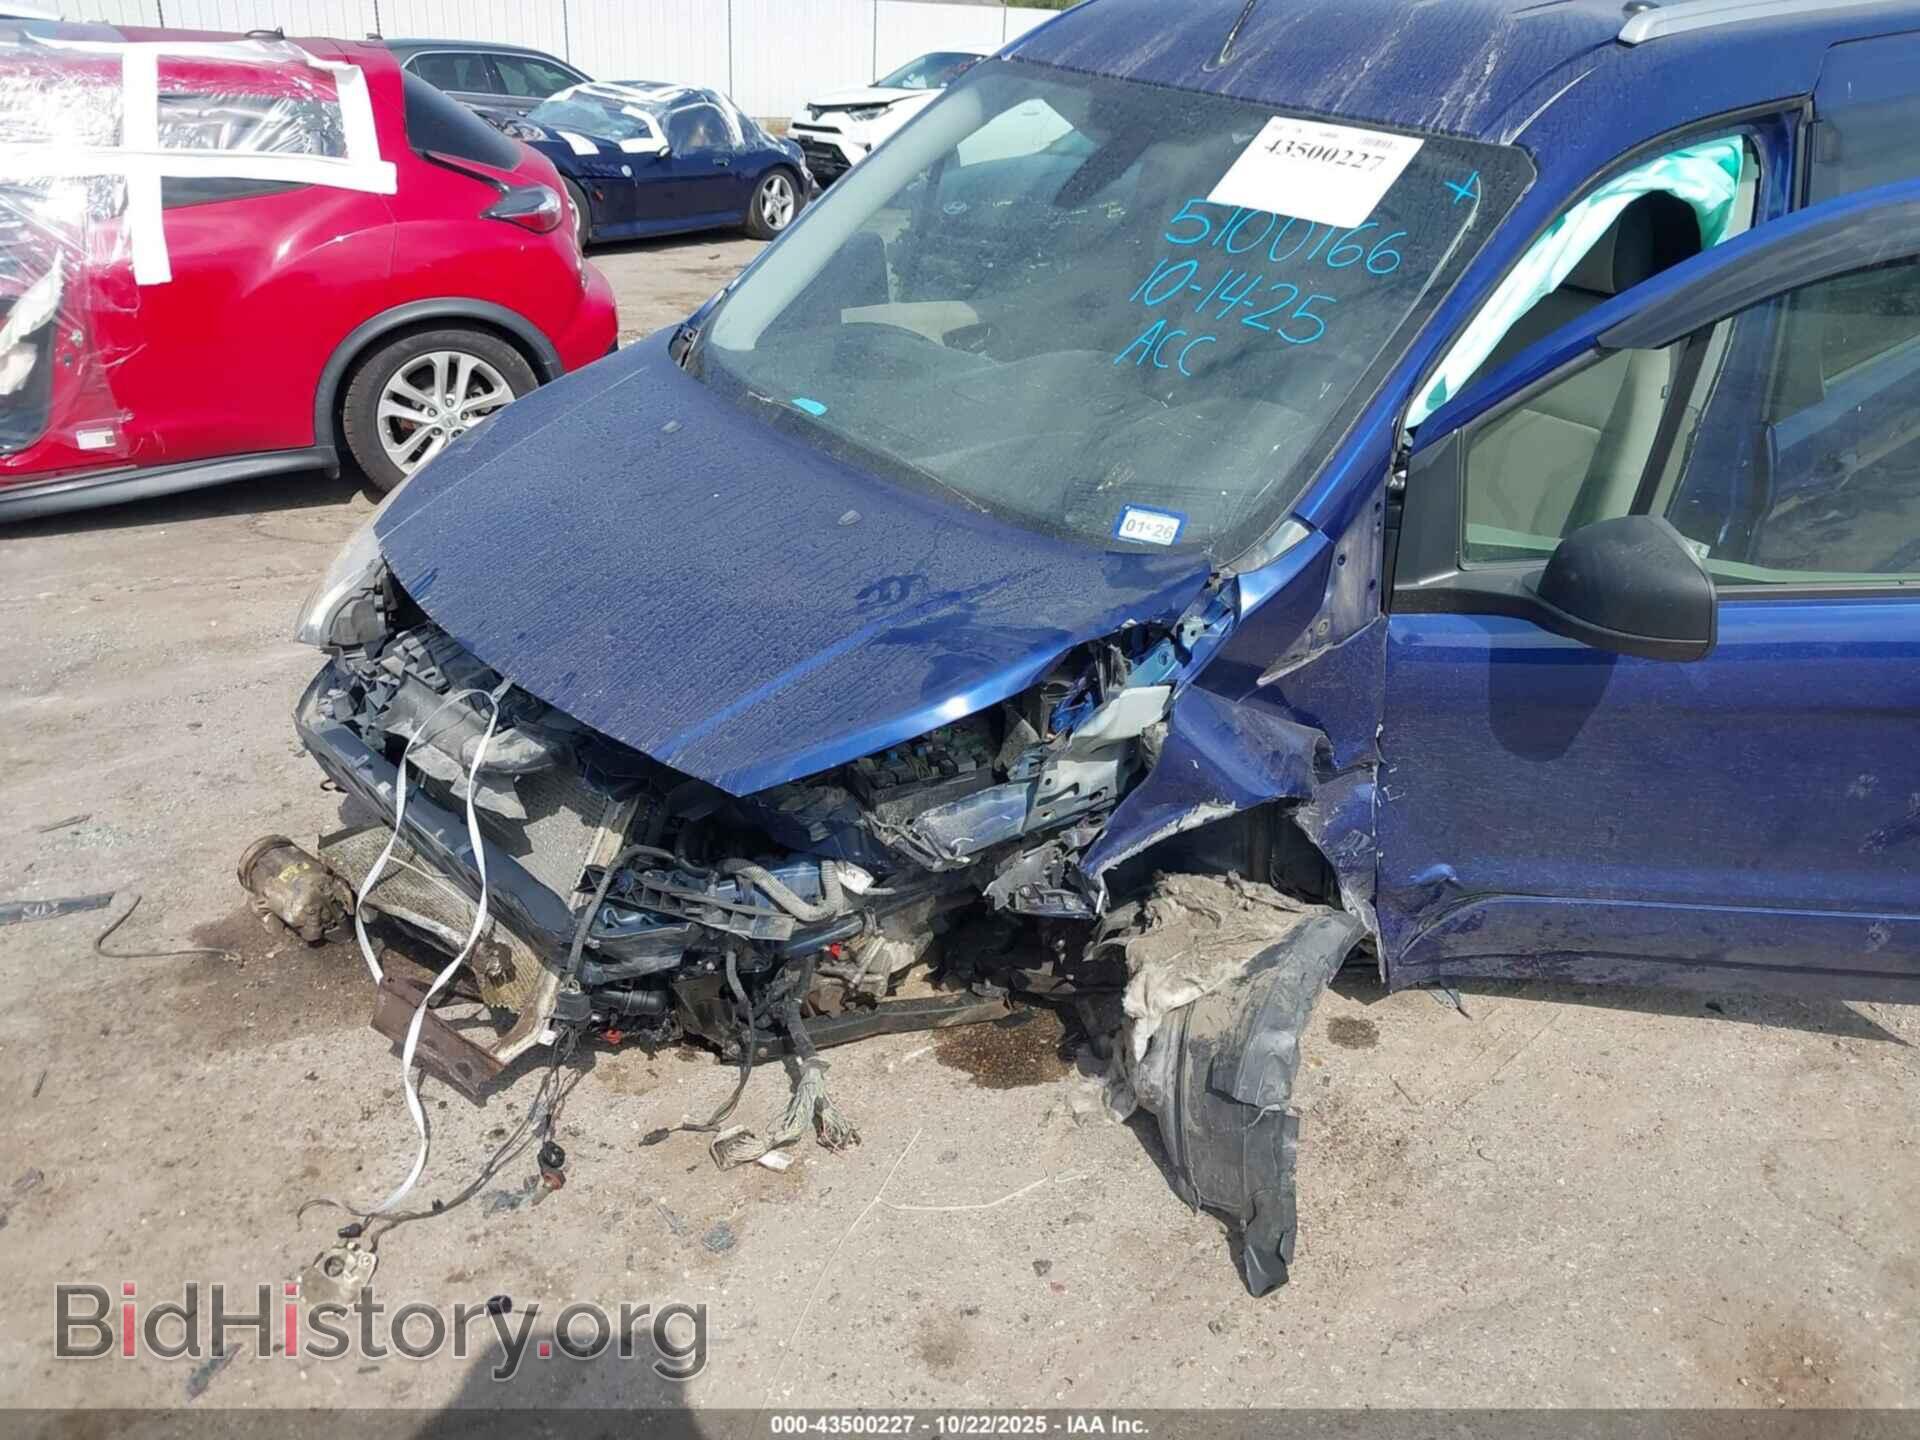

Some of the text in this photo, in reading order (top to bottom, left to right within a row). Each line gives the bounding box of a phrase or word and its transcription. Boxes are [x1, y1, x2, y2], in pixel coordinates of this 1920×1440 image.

[1264, 138, 1387, 172] 43500227
[1129, 257, 1337, 344] 10-14-25
[1113, 318, 1217, 376] ACC
